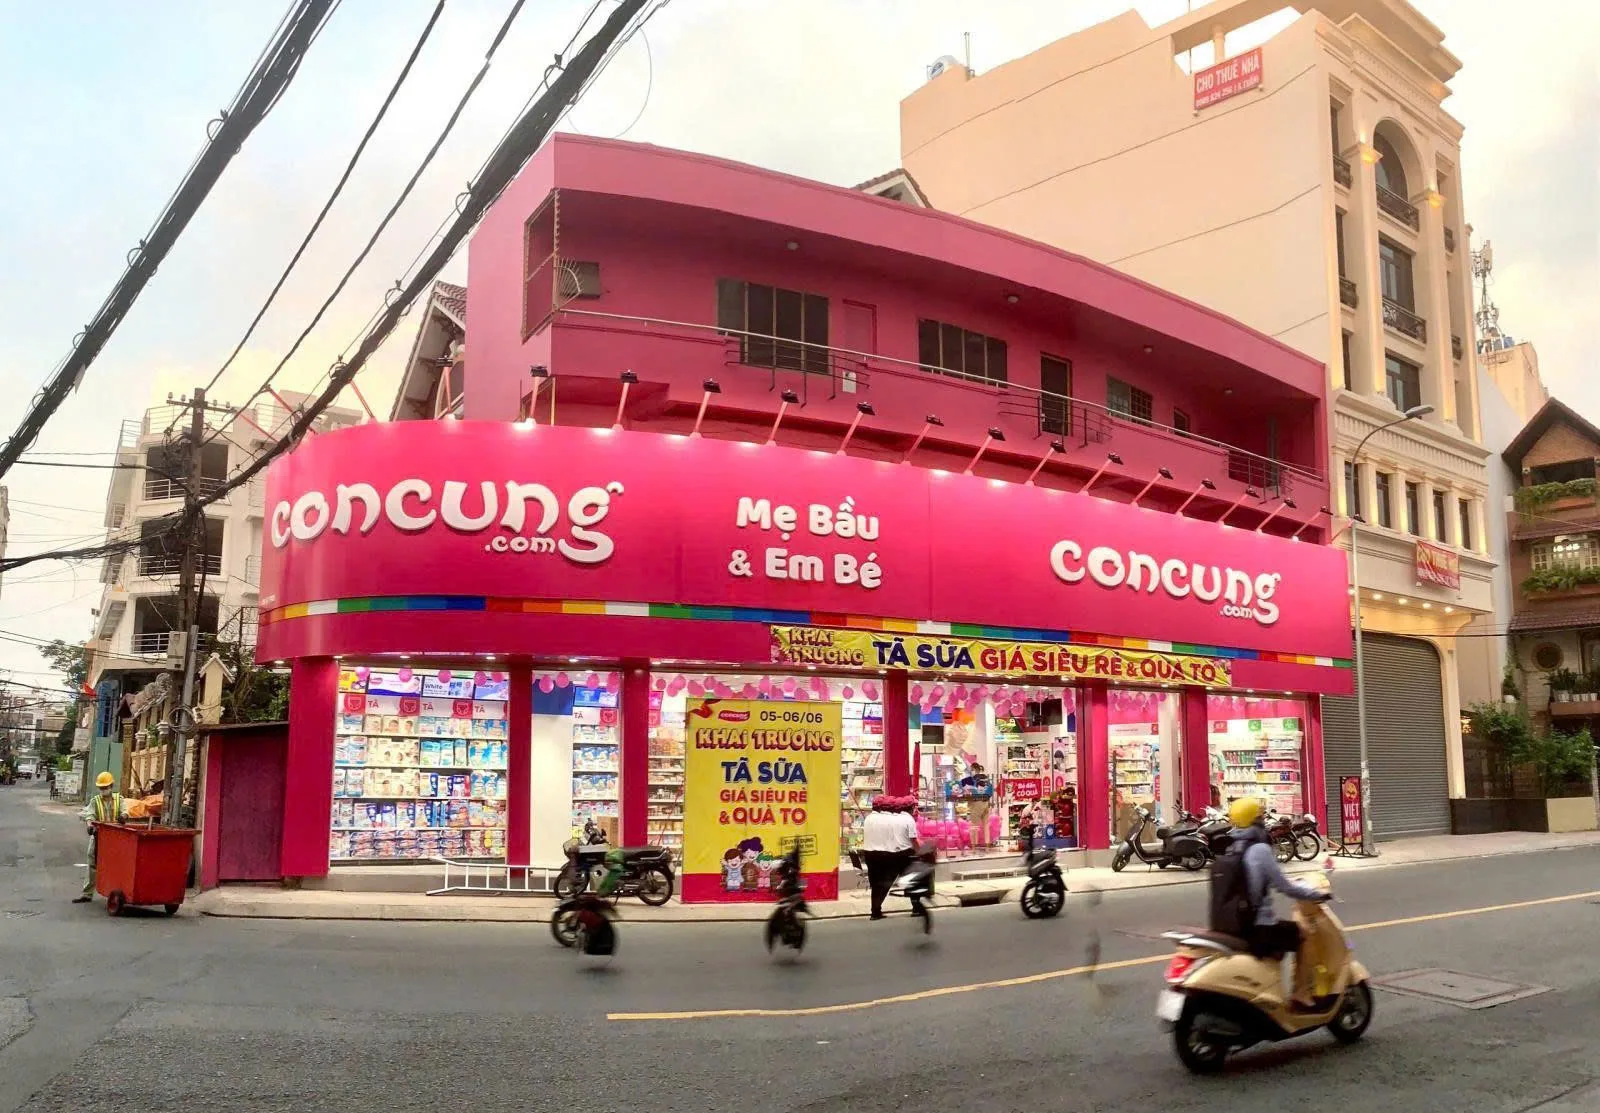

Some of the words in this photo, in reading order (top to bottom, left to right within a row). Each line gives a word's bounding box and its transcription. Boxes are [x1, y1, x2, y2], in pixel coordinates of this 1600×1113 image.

[1197, 73, 1214, 93] CHO
[1216, 60, 1239, 86] THUÊ
[1241, 51, 1260, 76] NHÀ
[271, 478, 624, 564] concung
[736, 497, 797, 541] Mẹ
[809, 496, 879, 540] Bầu
[485, 535, 556, 553] .com
[728, 550, 753, 577] &
[766, 548, 824, 582] Em
[835, 552, 882, 589] Bé
[1050, 540, 1281, 624] concung
[1220, 604, 1253, 619] .com
[873, 637, 911, 666] TÃ
[917, 641, 975, 670] SỮA
[980, 645, 1027, 671] GIÁ
[1032, 648, 1088, 673] SIÊU
[1095, 652, 1122, 675] RẺ
[1127, 661, 1138, 677] &
[1190, 663, 1216, 682] TO
[760, 711, 823, 723] 05-06/06
[752, 727, 834, 751] TRƯƠNG
[721, 757, 752, 783] TÃ
[758, 757, 807, 783] SỮA
[720, 787, 748, 803] GIÁ
[751, 788, 785, 803] SIÊU
[789, 787, 808, 803] RẺ
[719, 811, 730, 825] &
[732, 805, 775, 826] QUÀ
[780, 807, 807, 825] TO
[1344, 801, 1359, 818] VIỆT
[1345, 820, 1360, 834] NAM
